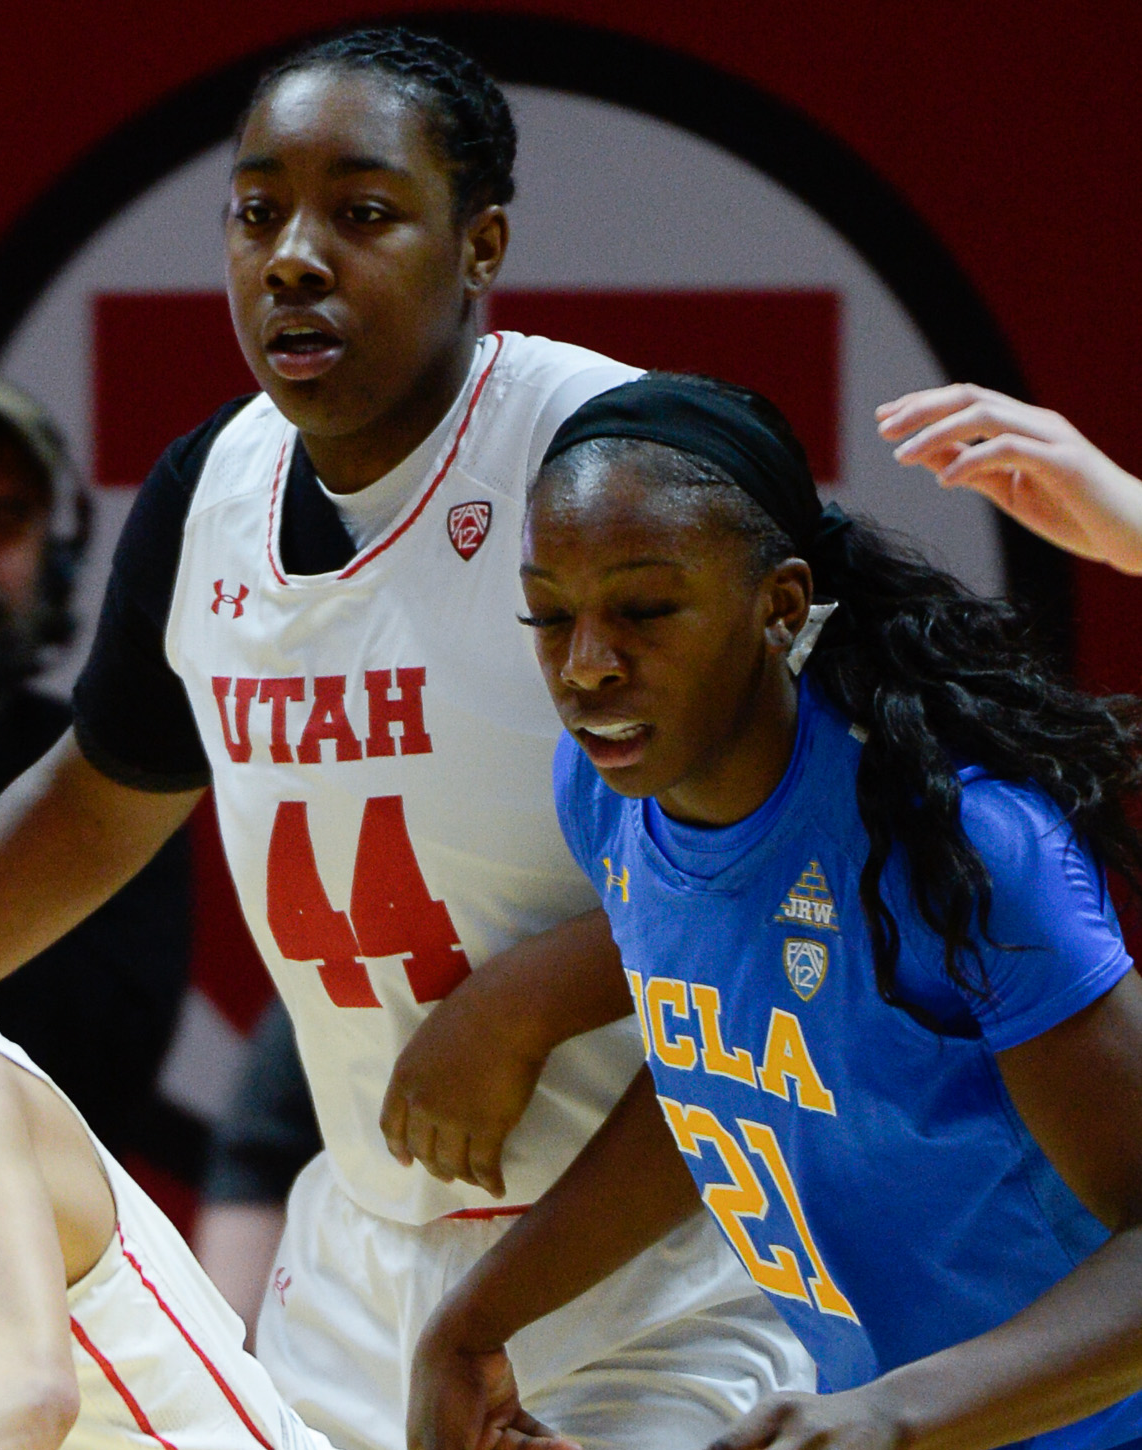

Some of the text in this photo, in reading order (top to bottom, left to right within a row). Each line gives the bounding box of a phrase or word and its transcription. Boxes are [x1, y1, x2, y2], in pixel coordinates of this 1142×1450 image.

[458, 526, 478, 549] 12
[211, 666, 433, 765] UTAH
[266, 795, 472, 1008] 44
[784, 896, 833, 924] JRW
[786, 941, 825, 979] PAC
[795, 965, 814, 989] 12
[656, 1094, 860, 1325] 21
